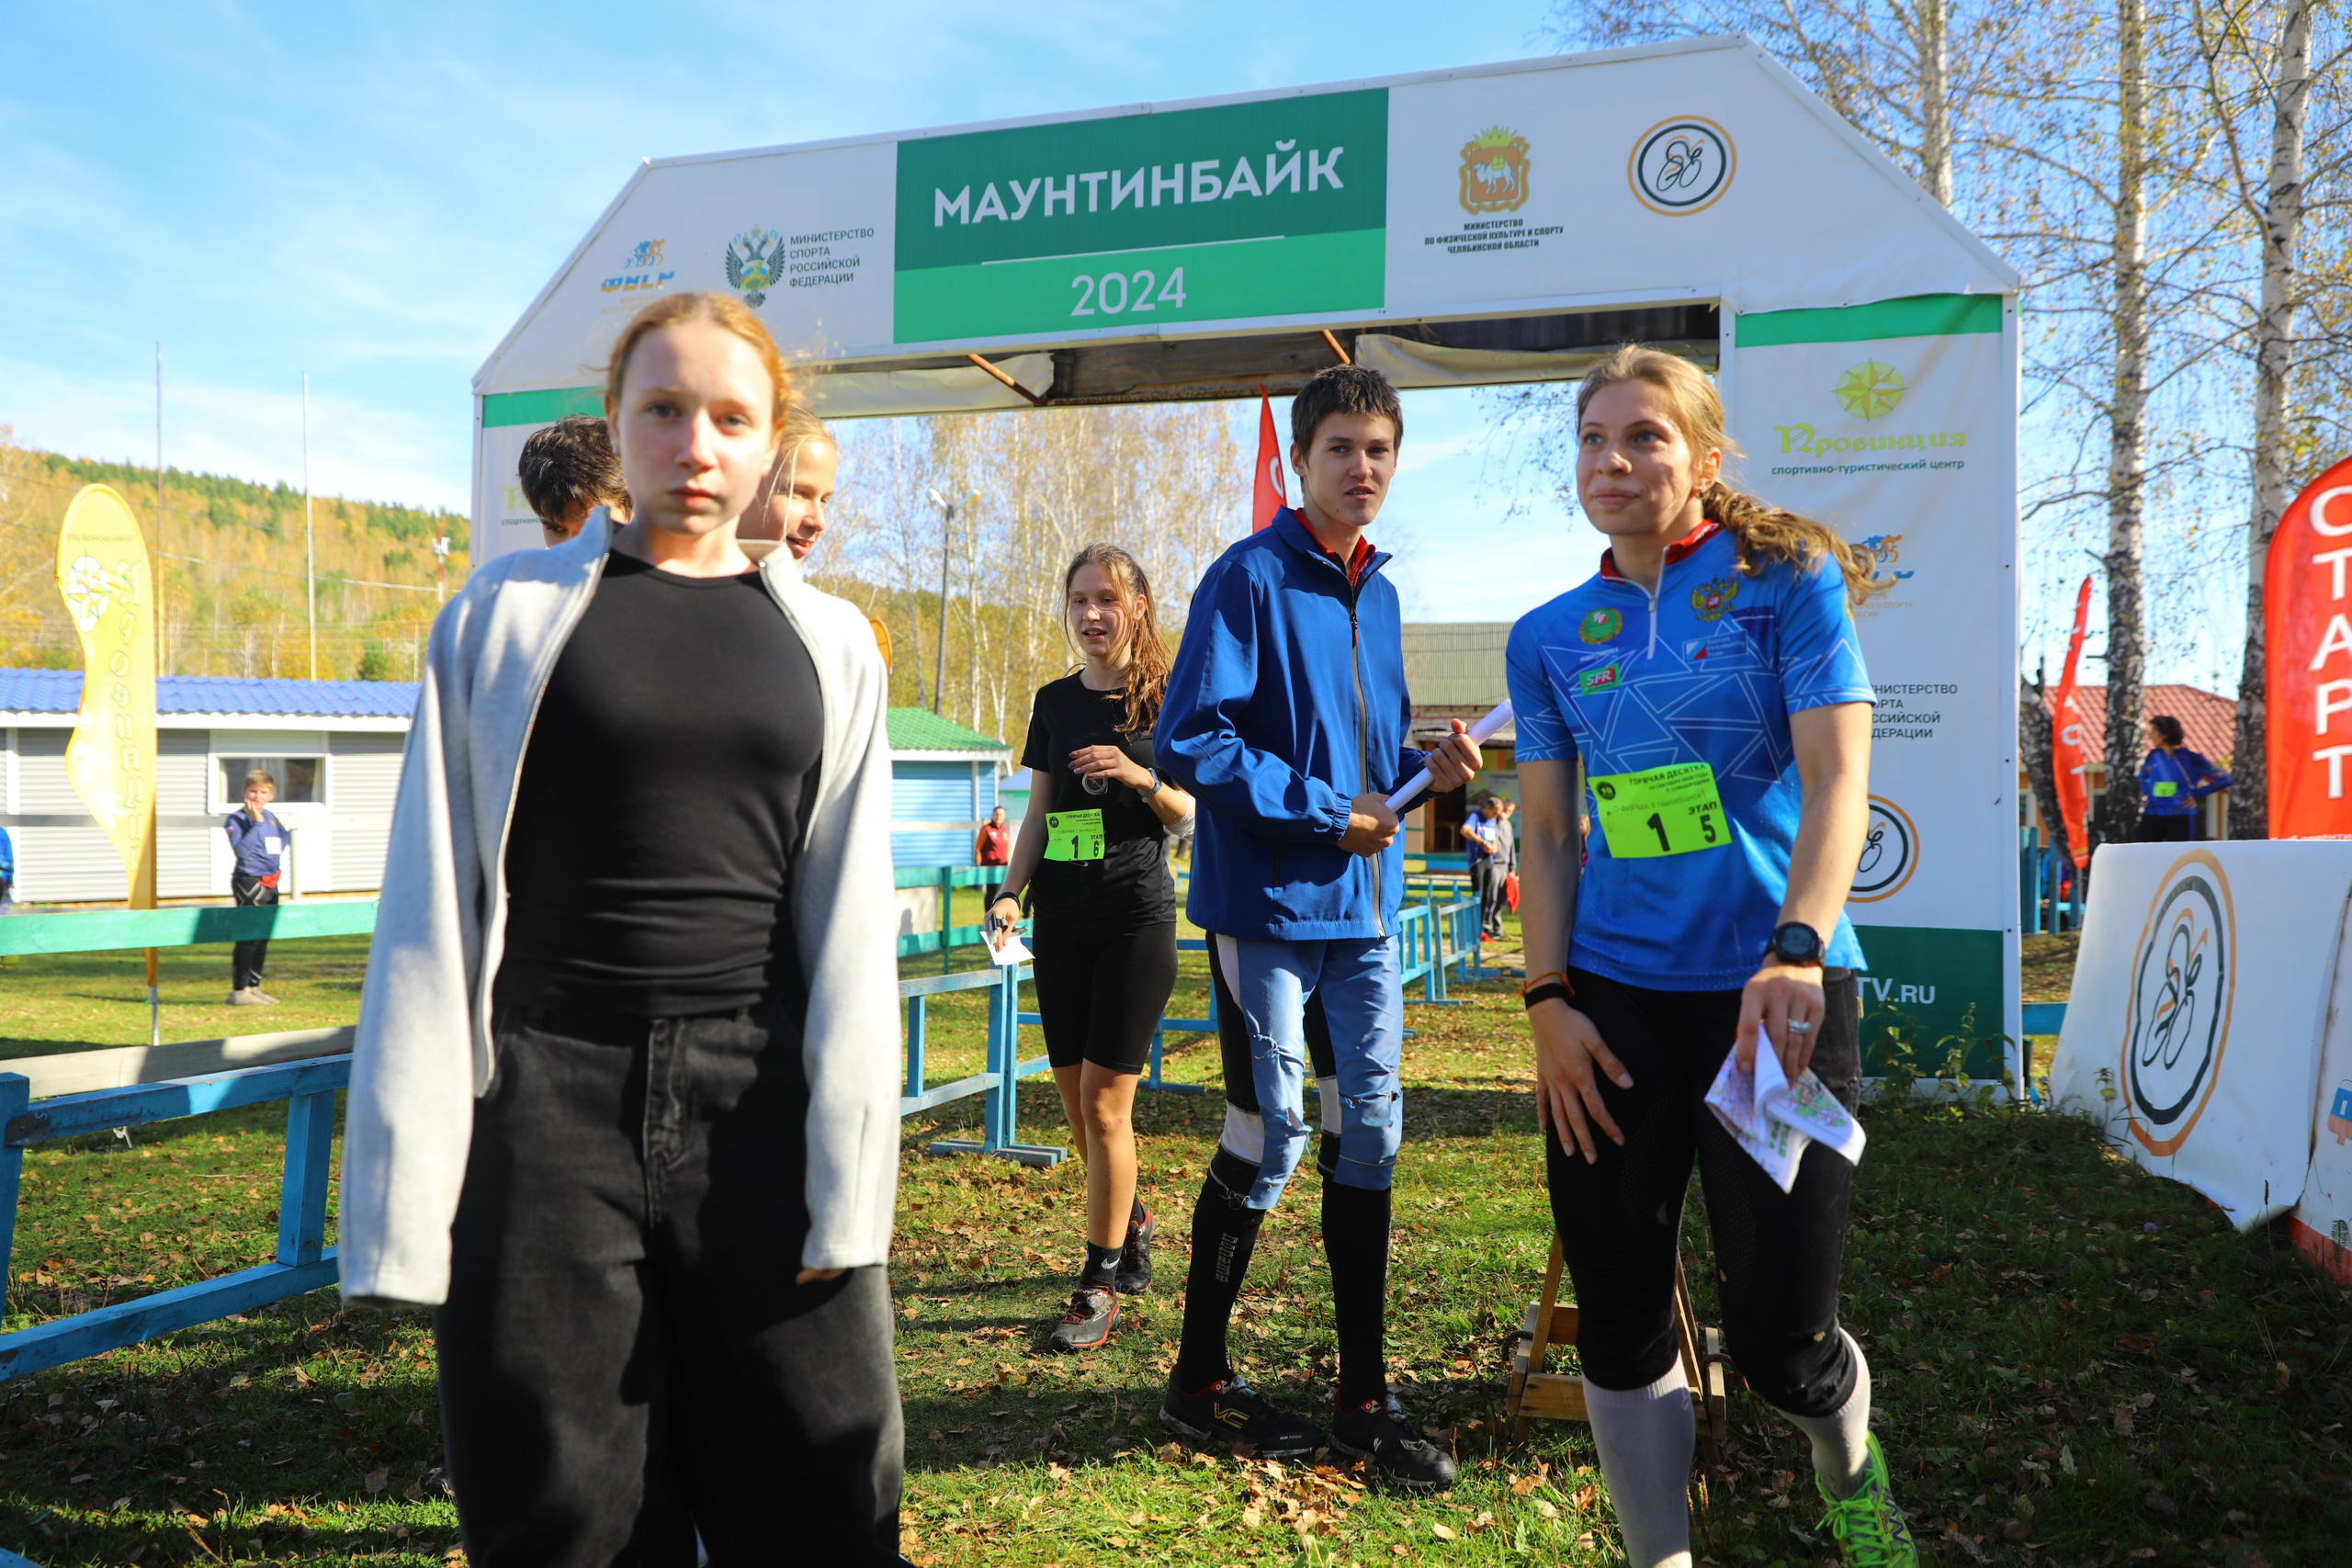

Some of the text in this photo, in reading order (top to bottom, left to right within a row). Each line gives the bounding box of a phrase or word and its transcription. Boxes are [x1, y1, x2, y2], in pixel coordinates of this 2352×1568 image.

[933, 139, 1345, 228] МАУНТИНБАЙК
[1464, 219, 1523, 231] МИНИСТЕРСТВО
[789, 228, 875, 246] МИНИСТЕРСТВО
[1424, 226, 1565, 245] ПО ФИЗИЧЕСКОЙ КУЛЬТУРЕ И СПОРТУ
[789, 246, 831, 260] СПОРТА
[1447, 239, 1540, 254] ЧЕЛЯБИНСКОЙ ОБЛАСТИ
[789, 257, 860, 275] РОССИЙСКОЙ
[789, 272, 854, 288] ФЕДЕРАЦИИ
[1070, 266, 1187, 317] 2024
[1772, 423, 1966, 458] Провинция
[1771, 459, 1965, 477] спортивно-туристический центр
[1587, 670, 1611, 686] SFR
[1871, 684, 1958, 694] НИСТЕРСТВО
[1871, 711, 1940, 724] ССИЙСКОЙ
[1871, 728, 1933, 739] ДЕРАЦИИ
[1629, 773, 1665, 785] ГОРЯЧАЯ
[1667, 764, 1706, 780] ДЕСЯТКА
[1688, 801, 1717, 816] ЭТАП
[1646, 813, 1670, 852] 1
[1700, 814, 1716, 843] 5
[1071, 835, 1079, 859] 1
[1093, 840, 1100, 858] 6
